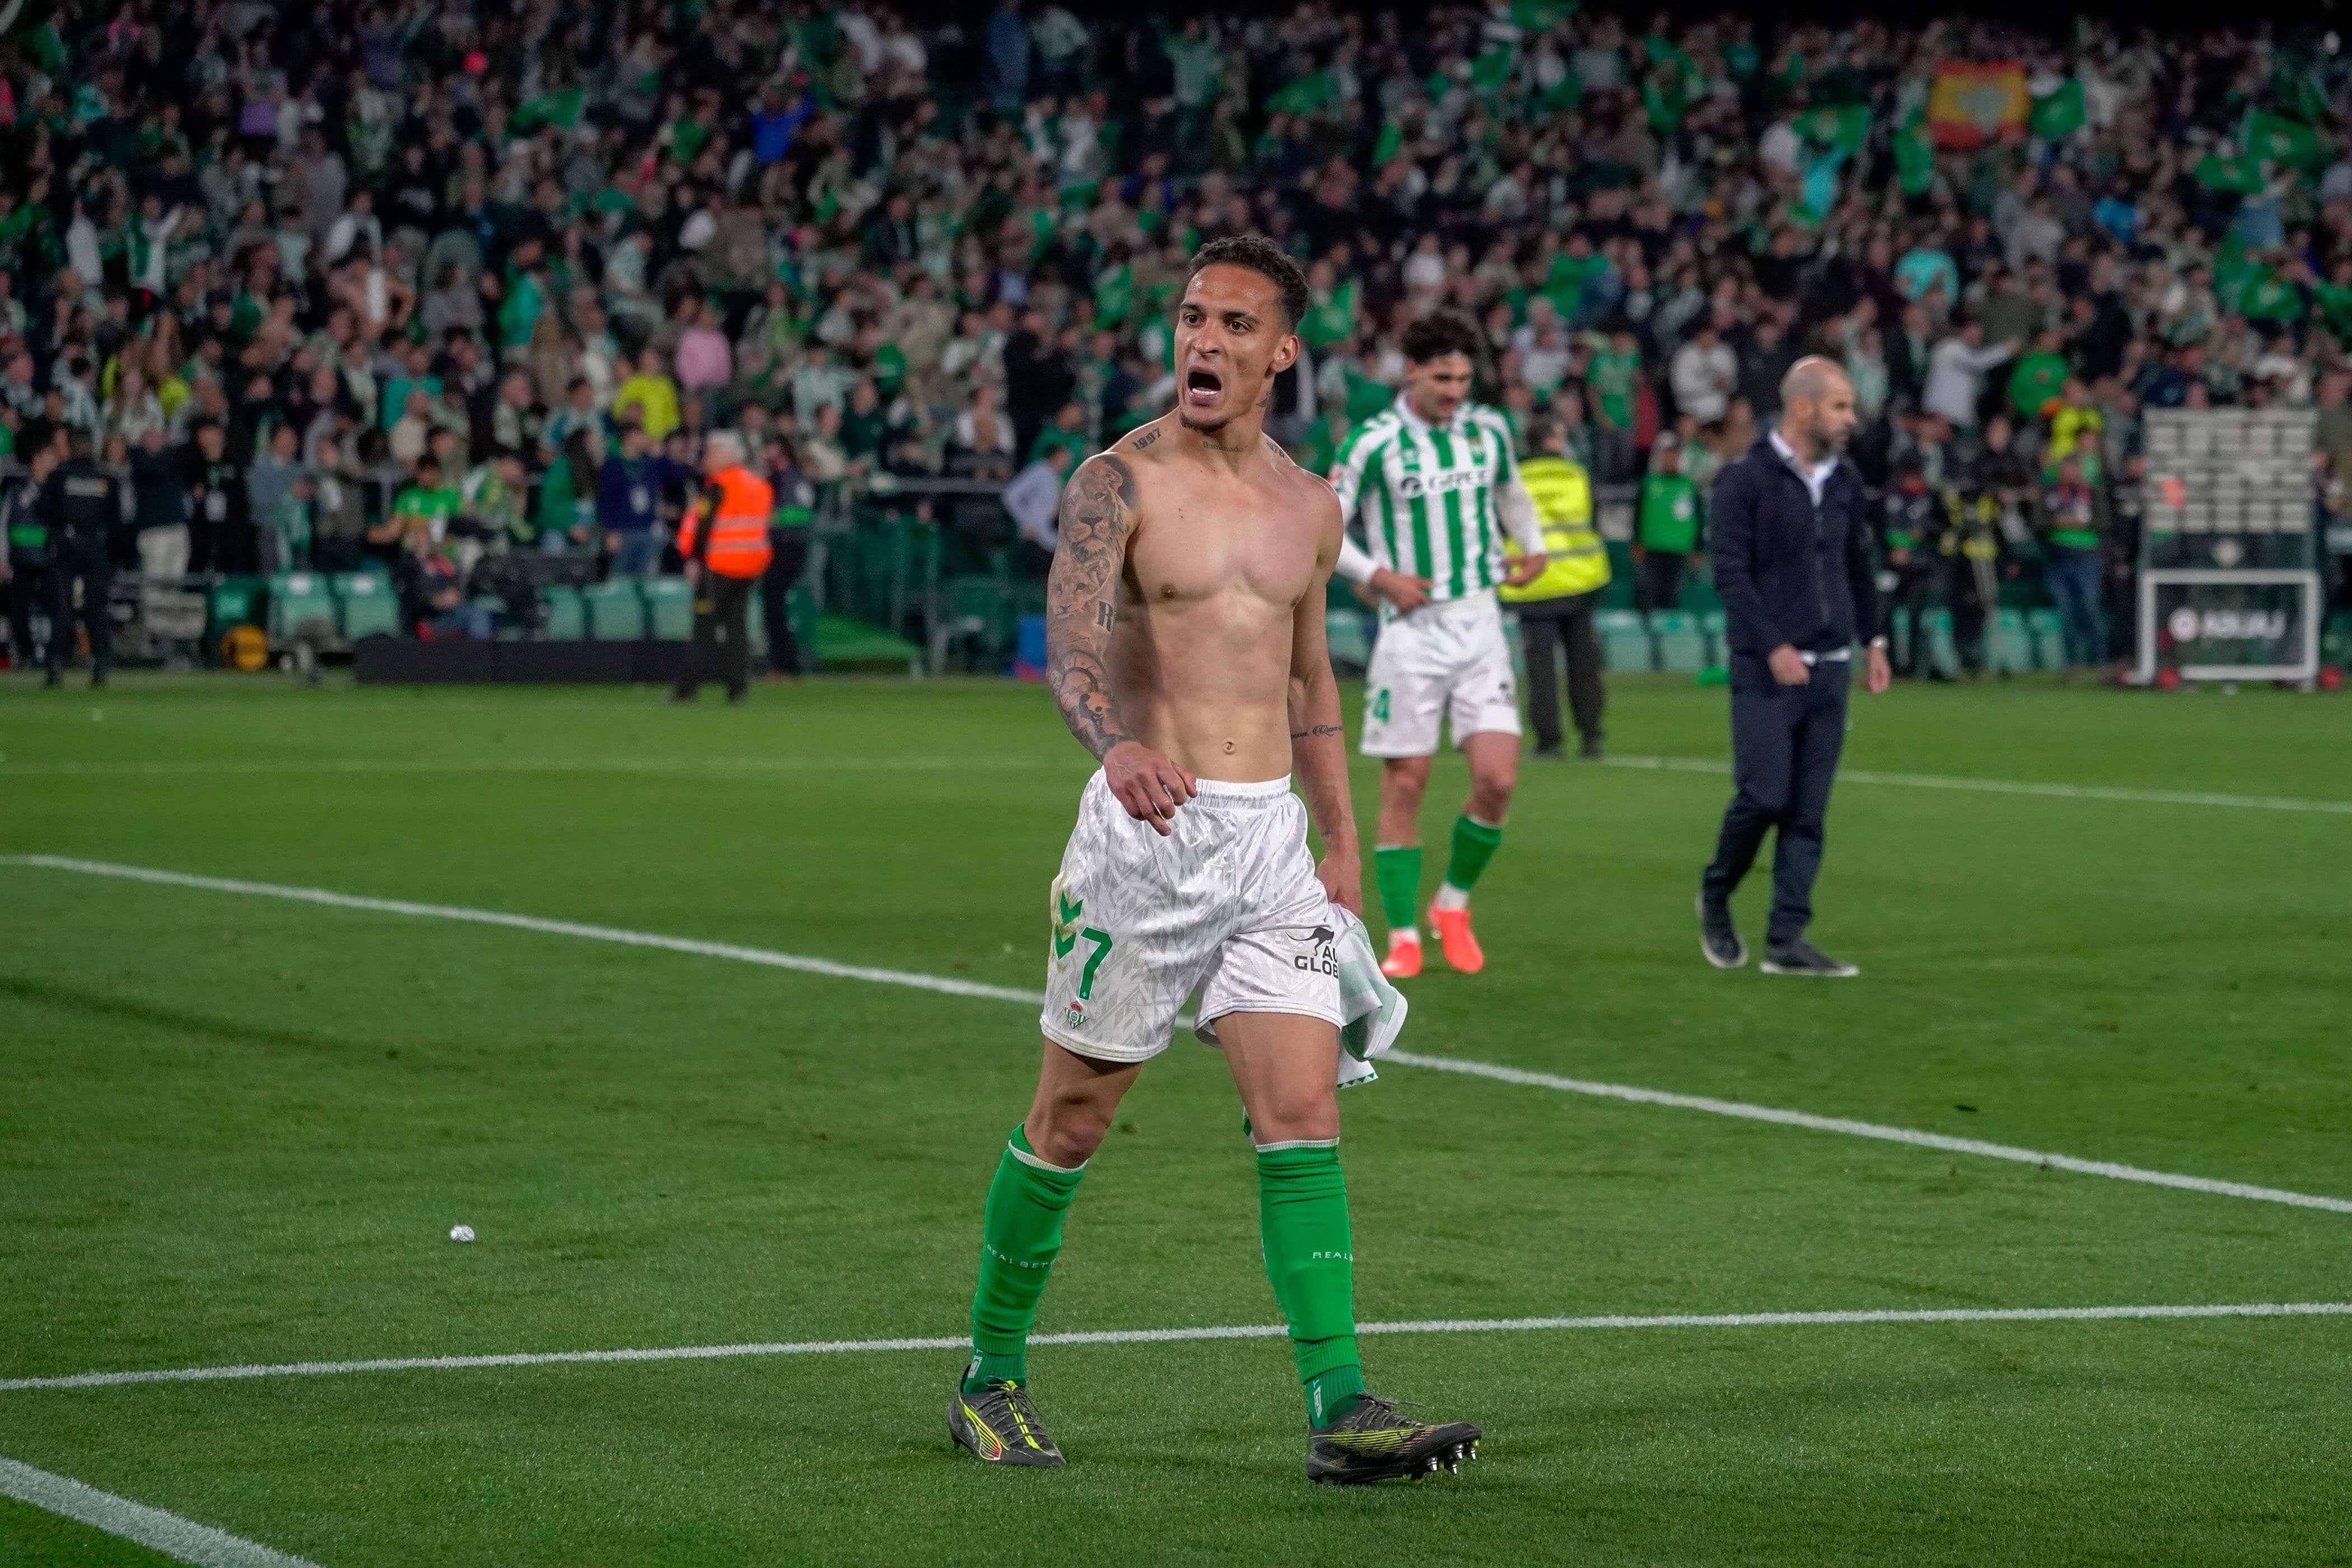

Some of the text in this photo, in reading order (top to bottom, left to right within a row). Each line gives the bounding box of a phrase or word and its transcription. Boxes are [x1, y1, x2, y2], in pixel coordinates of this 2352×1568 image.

[1096, 601, 1113, 632] R
[1080, 926, 1113, 1001] 7
[1294, 955, 1338, 979] GLOB
[1312, 1251, 1348, 1260] REAL
